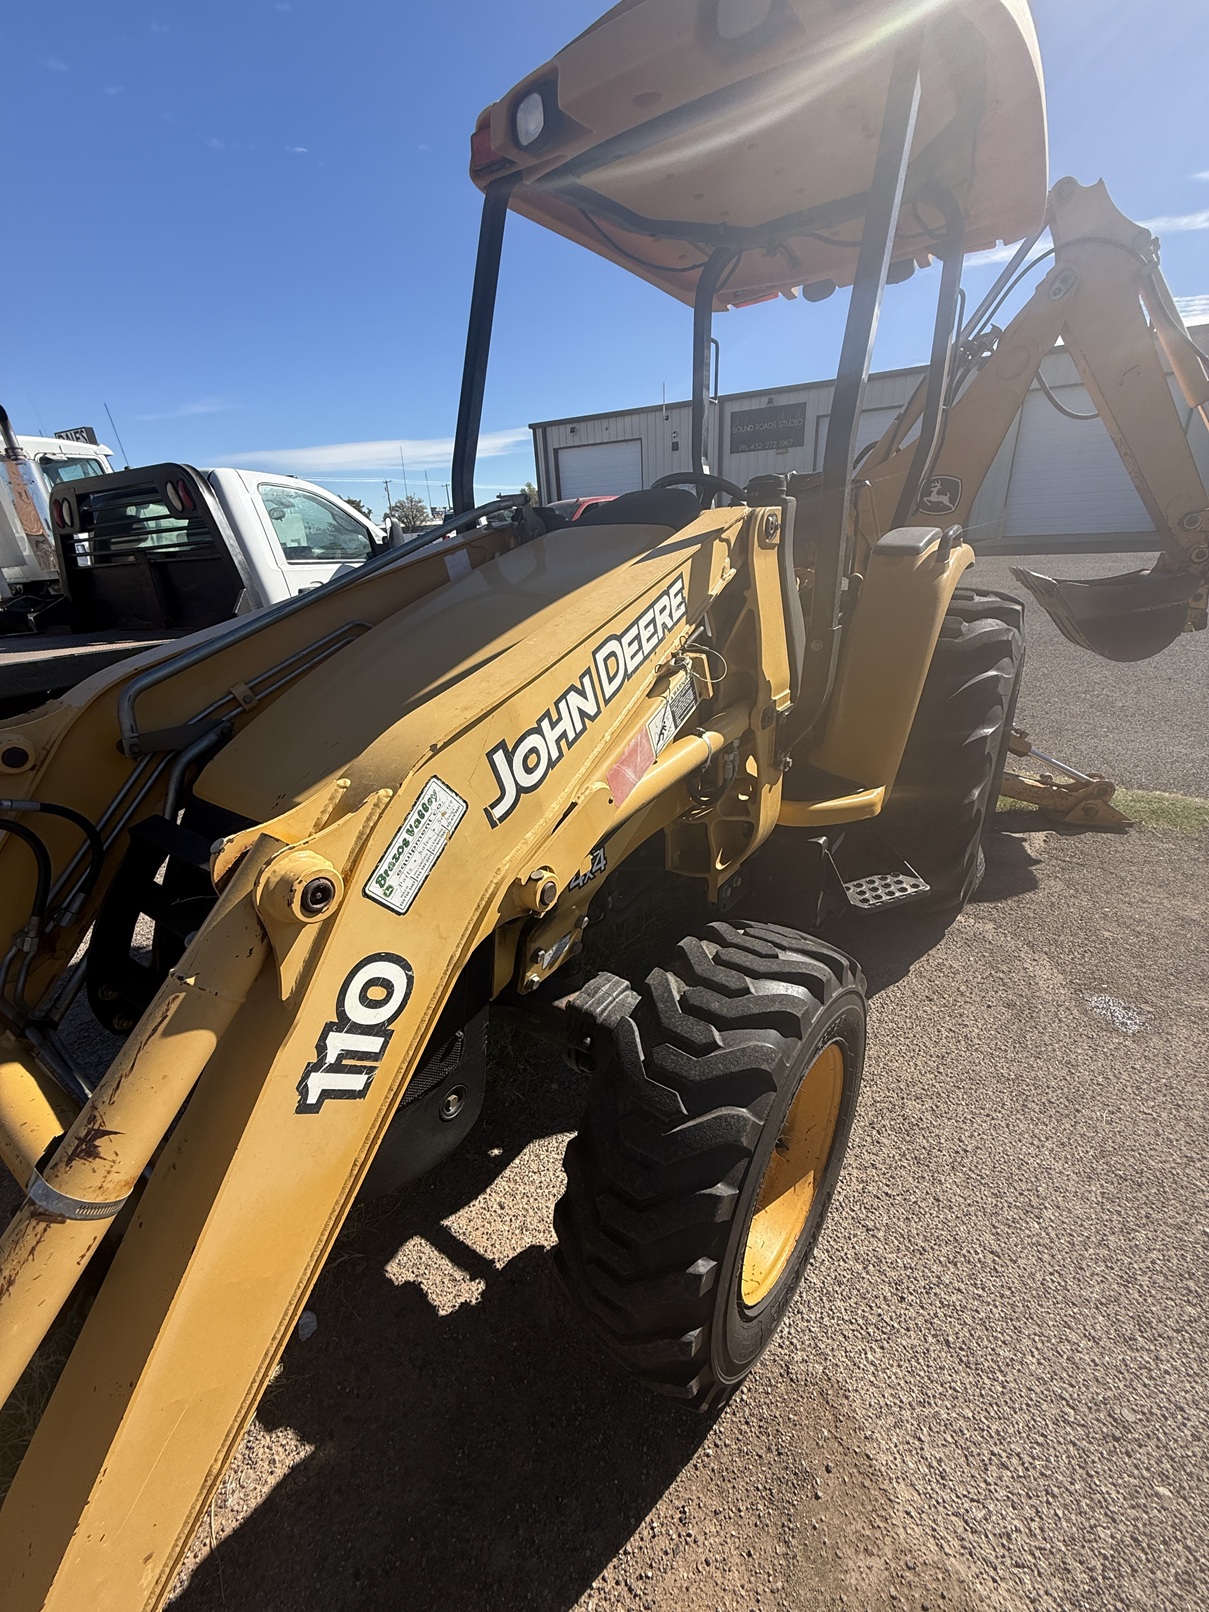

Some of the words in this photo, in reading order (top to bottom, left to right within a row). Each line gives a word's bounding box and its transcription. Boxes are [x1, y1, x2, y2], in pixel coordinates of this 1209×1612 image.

[732, 424, 754, 434] SOUND
[755, 421, 777, 431] ROADS
[778, 418, 803, 428] STUDIO
[484, 667, 602, 829] JOHN
[592, 572, 687, 706] DEERE
[374, 836, 411, 889] Brazos
[405, 788, 439, 837] Valley
[436, 799, 454, 824] Seice
[395, 818, 433, 877] equipment
[568, 847, 608, 892] 4x4
[294, 952, 414, 1114] 110
